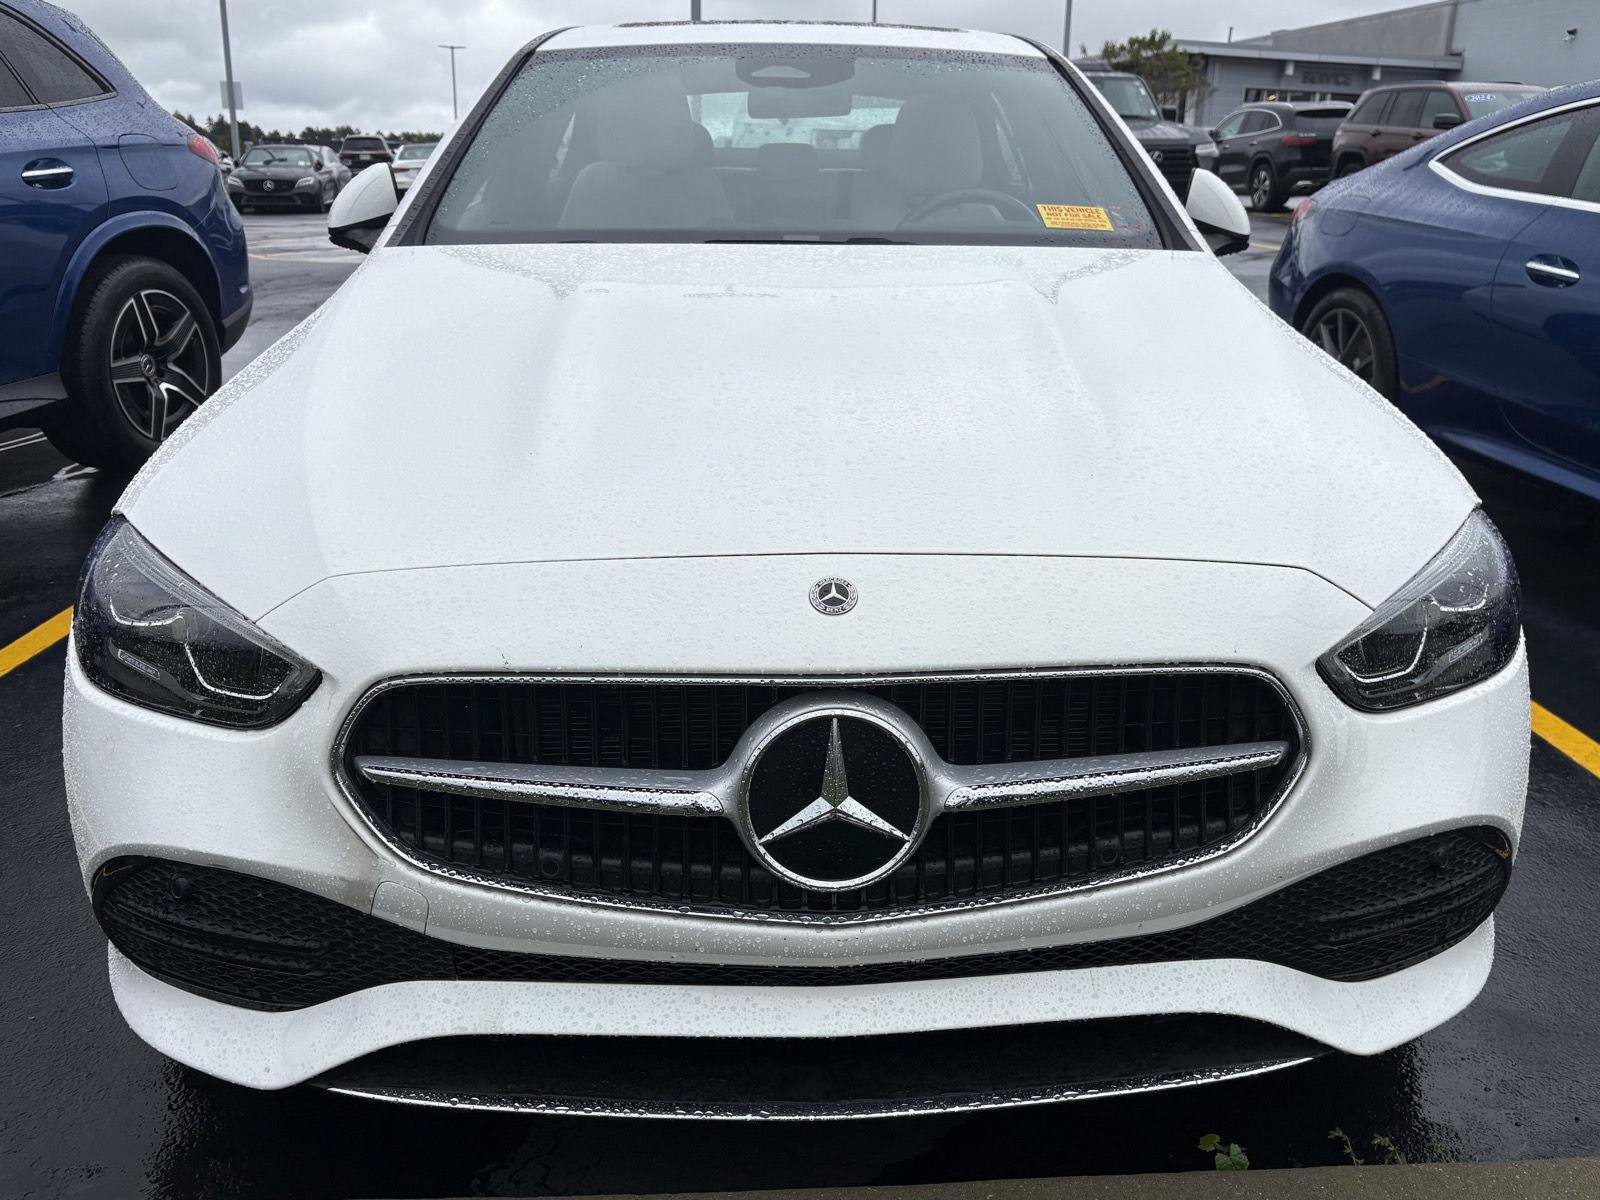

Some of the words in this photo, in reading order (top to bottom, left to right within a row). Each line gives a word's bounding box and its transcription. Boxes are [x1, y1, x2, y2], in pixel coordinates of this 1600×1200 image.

[1302, 71, 1352, 86] SERVICE
[1041, 205, 1063, 213] THIS
[1064, 206, 1101, 214] VEHICLE
